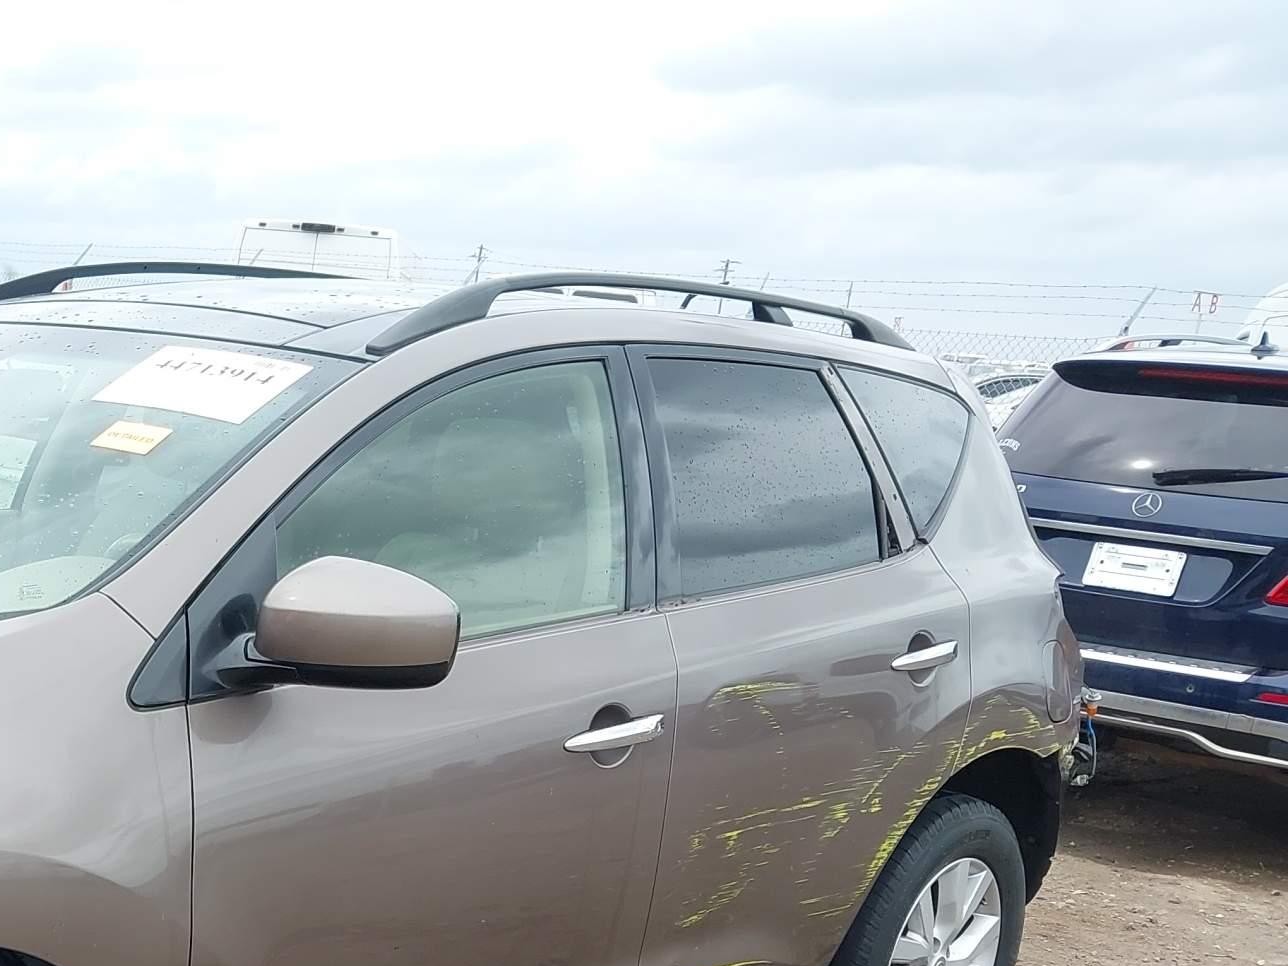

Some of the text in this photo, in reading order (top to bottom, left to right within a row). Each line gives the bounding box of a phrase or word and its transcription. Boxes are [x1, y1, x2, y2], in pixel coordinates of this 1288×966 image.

[1192, 293, 1219, 314] A B
[156, 359, 276, 385] 44713914
